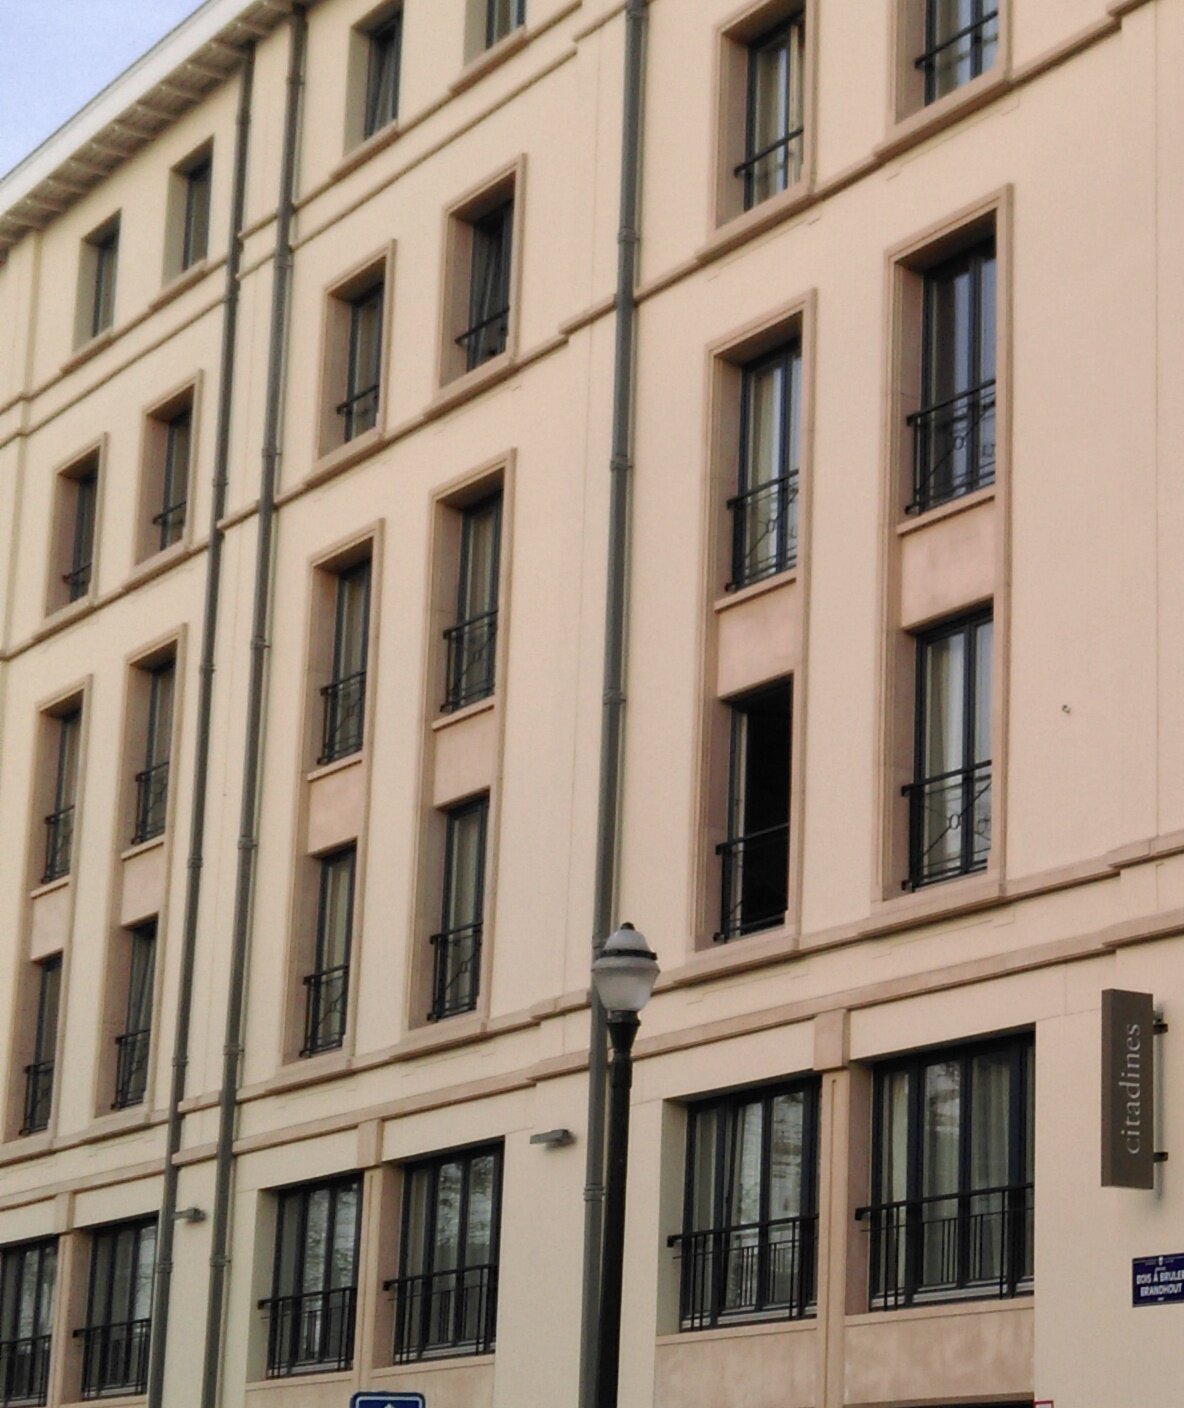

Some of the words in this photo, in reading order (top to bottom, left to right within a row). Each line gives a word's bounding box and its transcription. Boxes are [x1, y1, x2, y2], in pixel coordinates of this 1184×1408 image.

[1118, 1023, 1141, 1155] citadines
[1136, 1273, 1152, 1285] BOIS
[1140, 1282, 1183, 1297] BRANDHOUT
